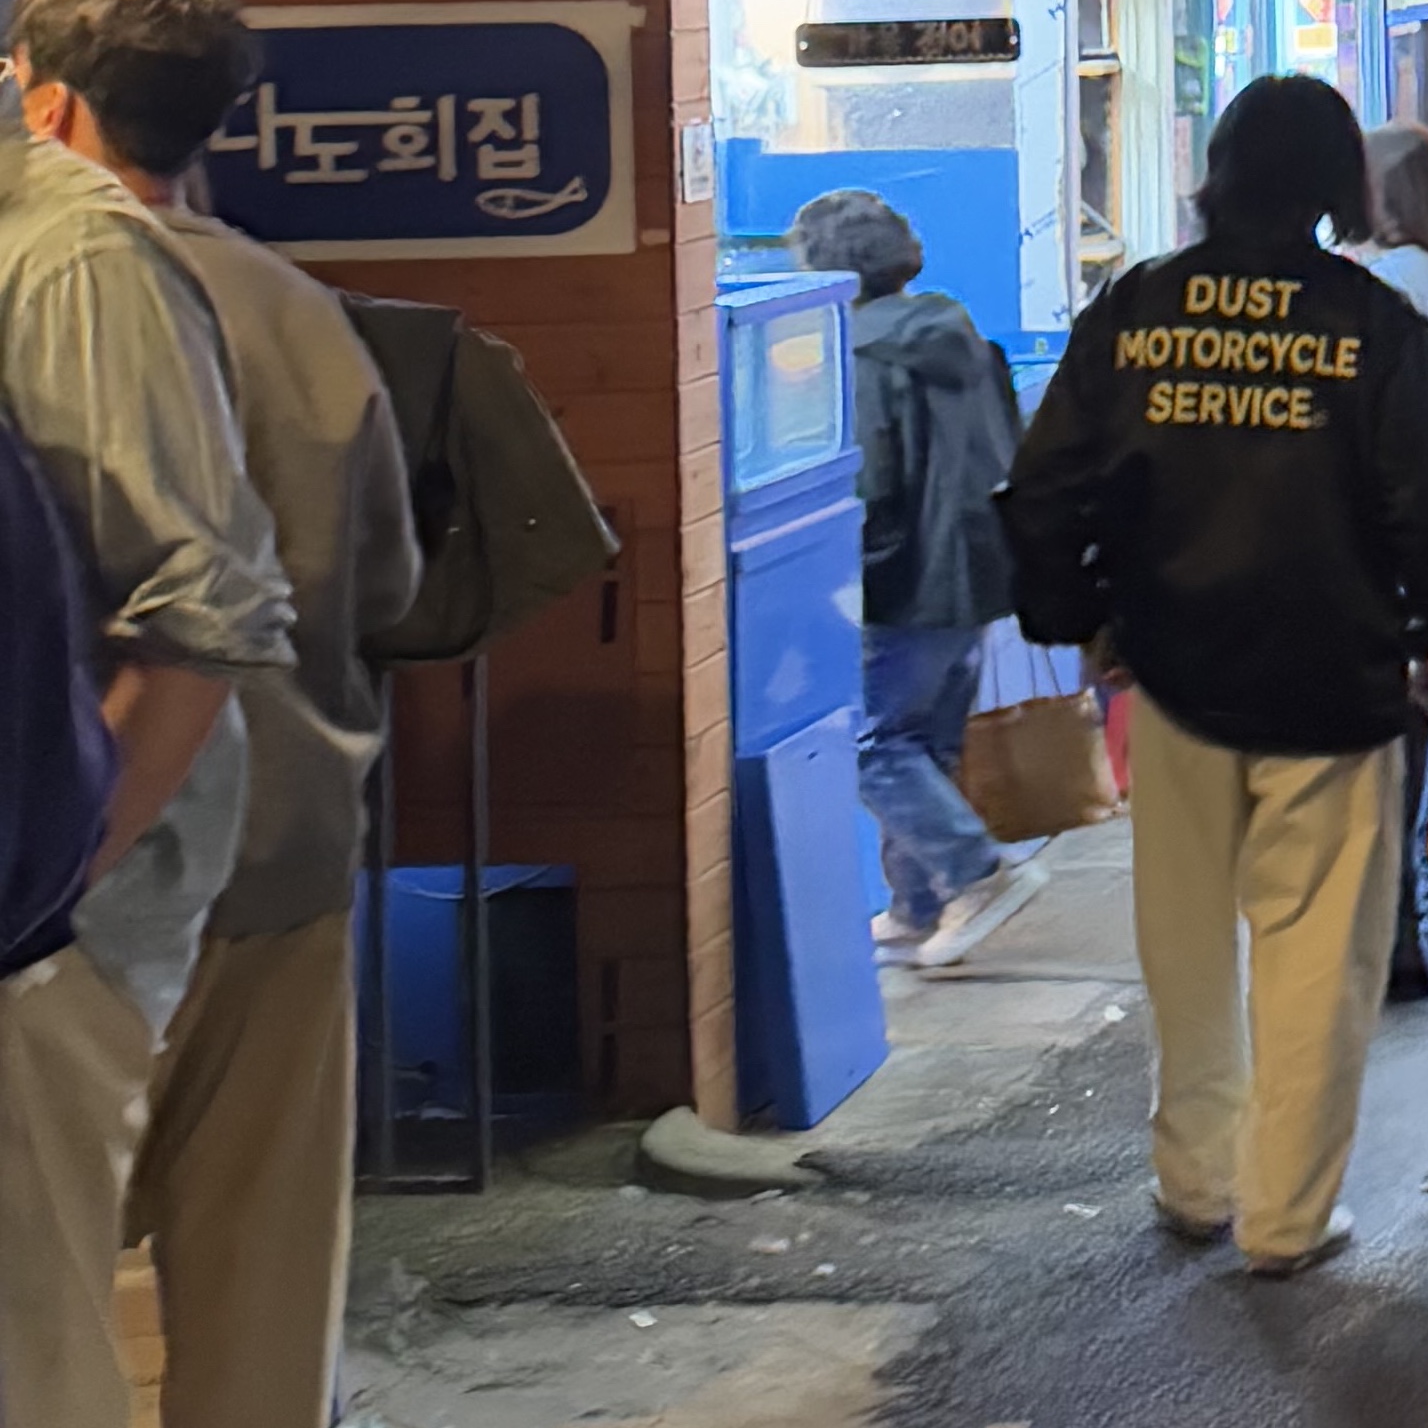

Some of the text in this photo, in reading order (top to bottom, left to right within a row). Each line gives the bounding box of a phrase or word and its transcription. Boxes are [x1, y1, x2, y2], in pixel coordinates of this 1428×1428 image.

[1185, 275, 1303, 320] DUST
[1115, 327, 1361, 379] MOTORCYCLE
[1146, 381, 1314, 429] SERVICE
